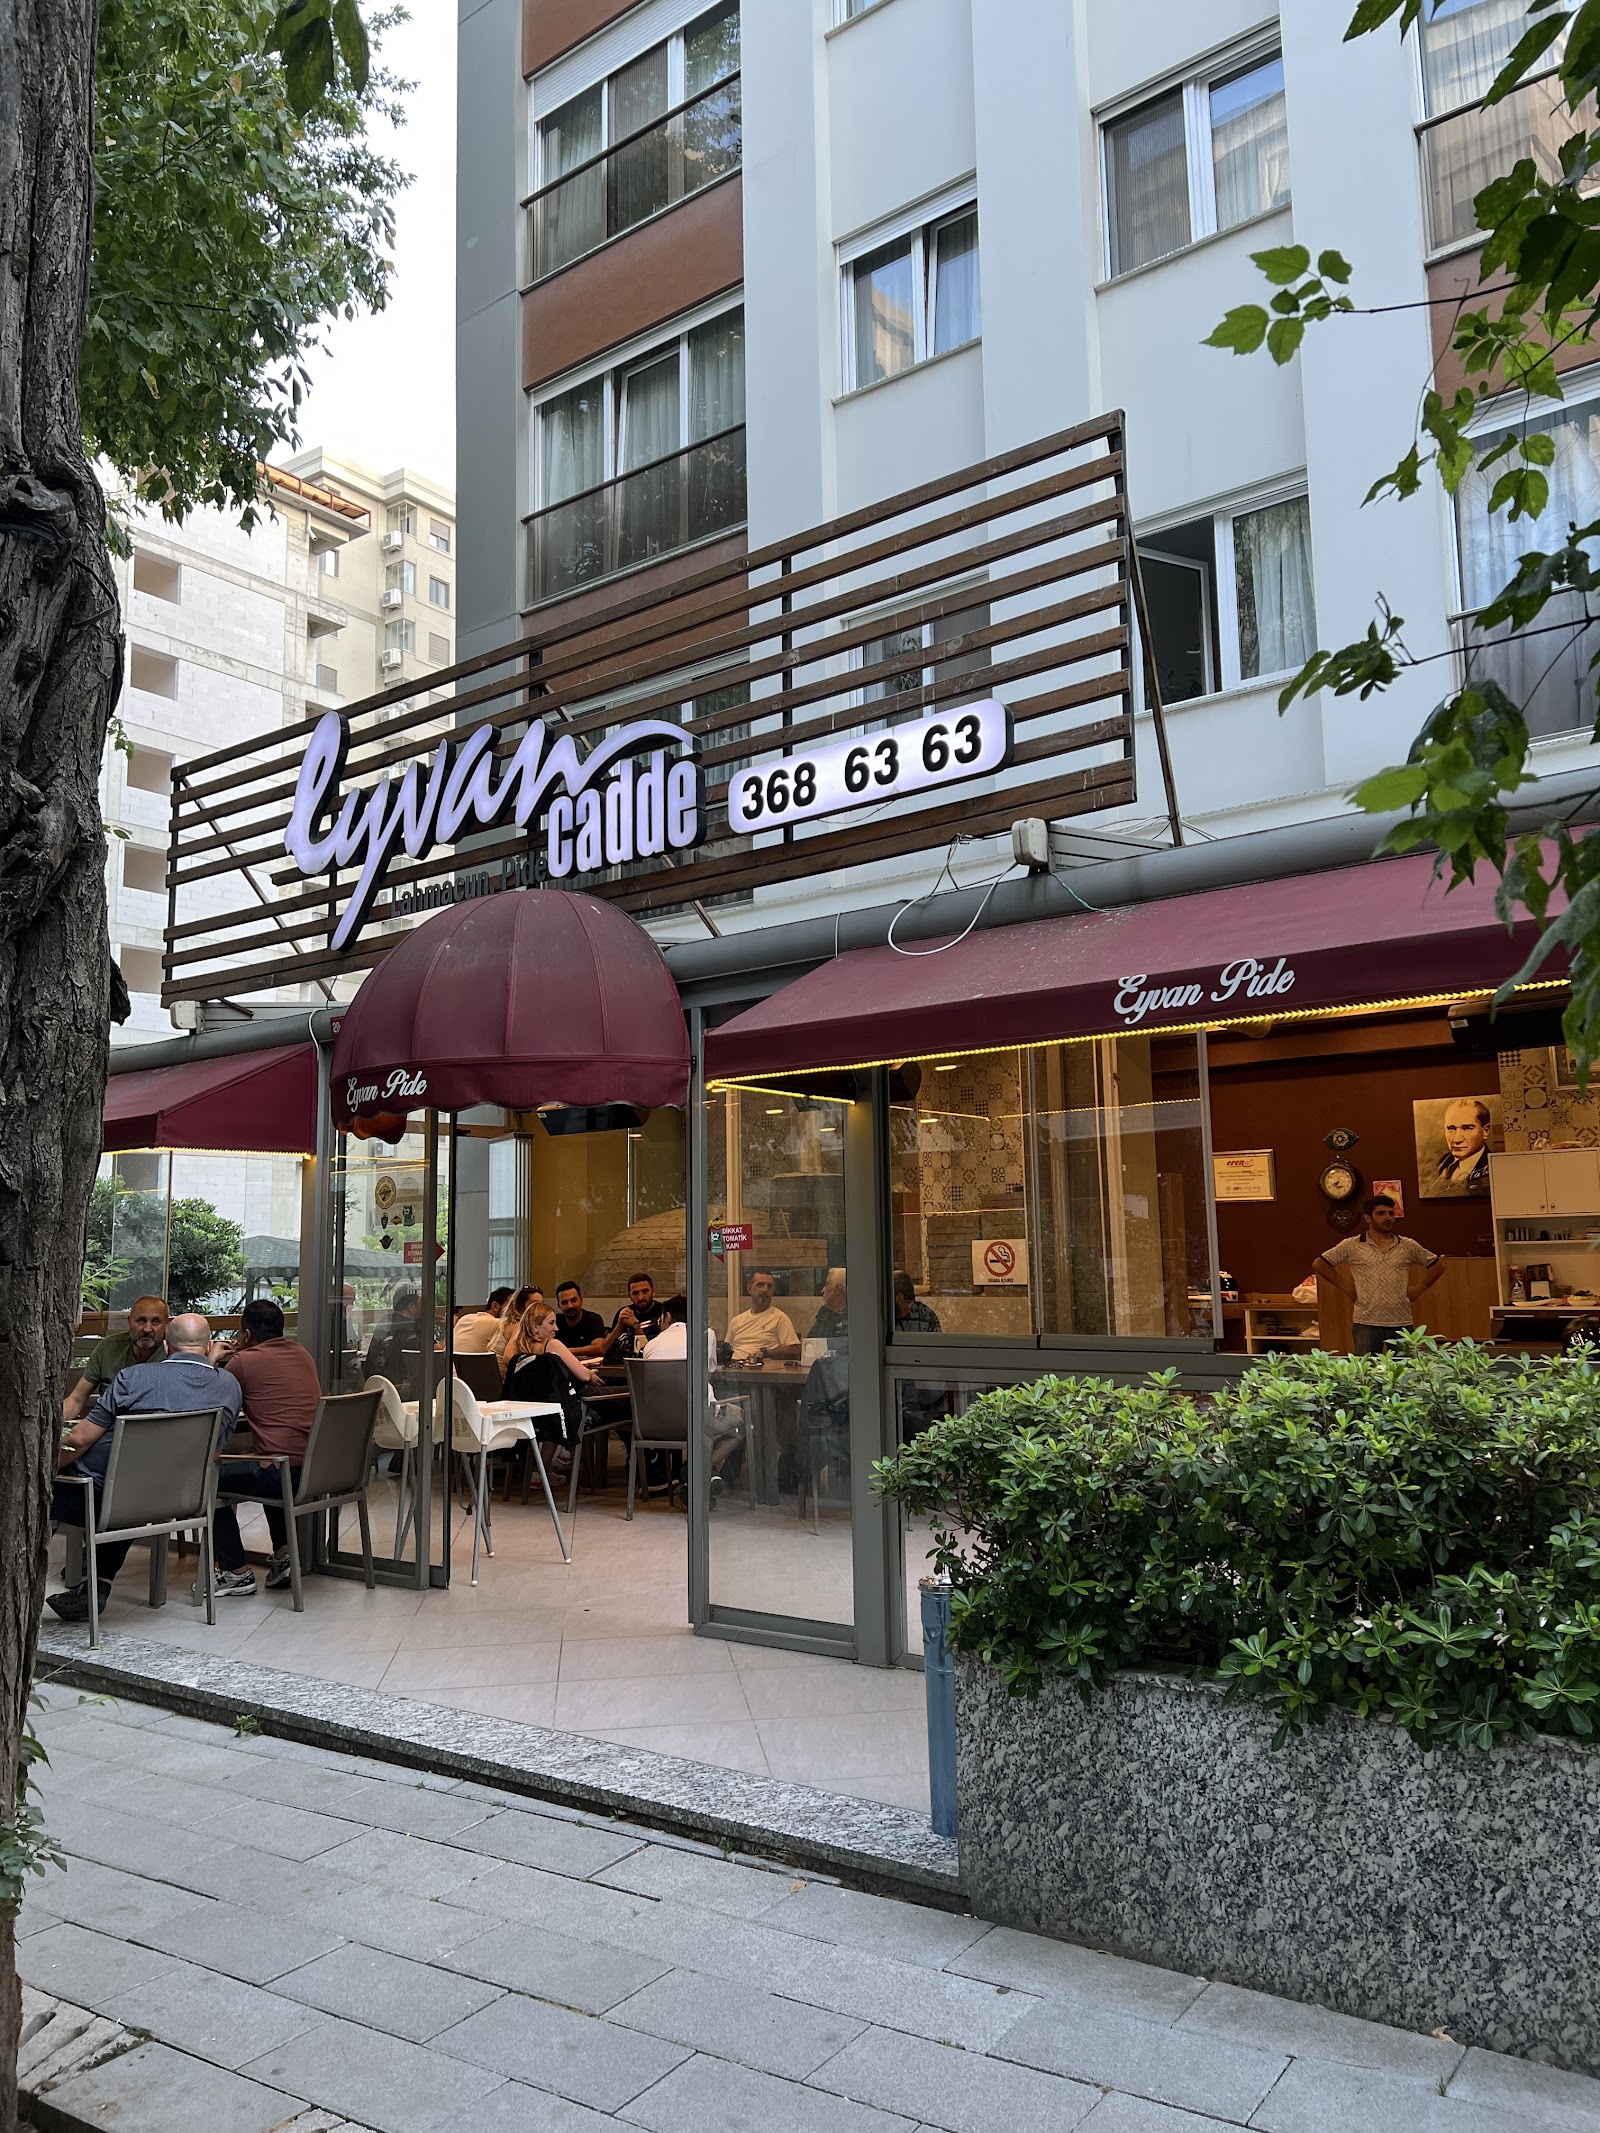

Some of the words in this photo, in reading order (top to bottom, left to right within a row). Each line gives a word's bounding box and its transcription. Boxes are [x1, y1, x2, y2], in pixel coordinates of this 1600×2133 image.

[742, 761, 817, 820] 368
[844, 738, 900, 793] 63
[922, 714, 983, 772] 63
[548, 750, 701, 878] cadde
[502, 850, 549, 891] Pide
[1113, 973, 1204, 1025] Eyvan
[1210, 957, 1296, 1002] Pide
[346, 1077, 379, 1113] Eyvan
[381, 1069, 428, 1099] Pide
[722, 1226, 743, 1234] DİKKAT
[722, 1234, 747, 1242] TOMATİK
